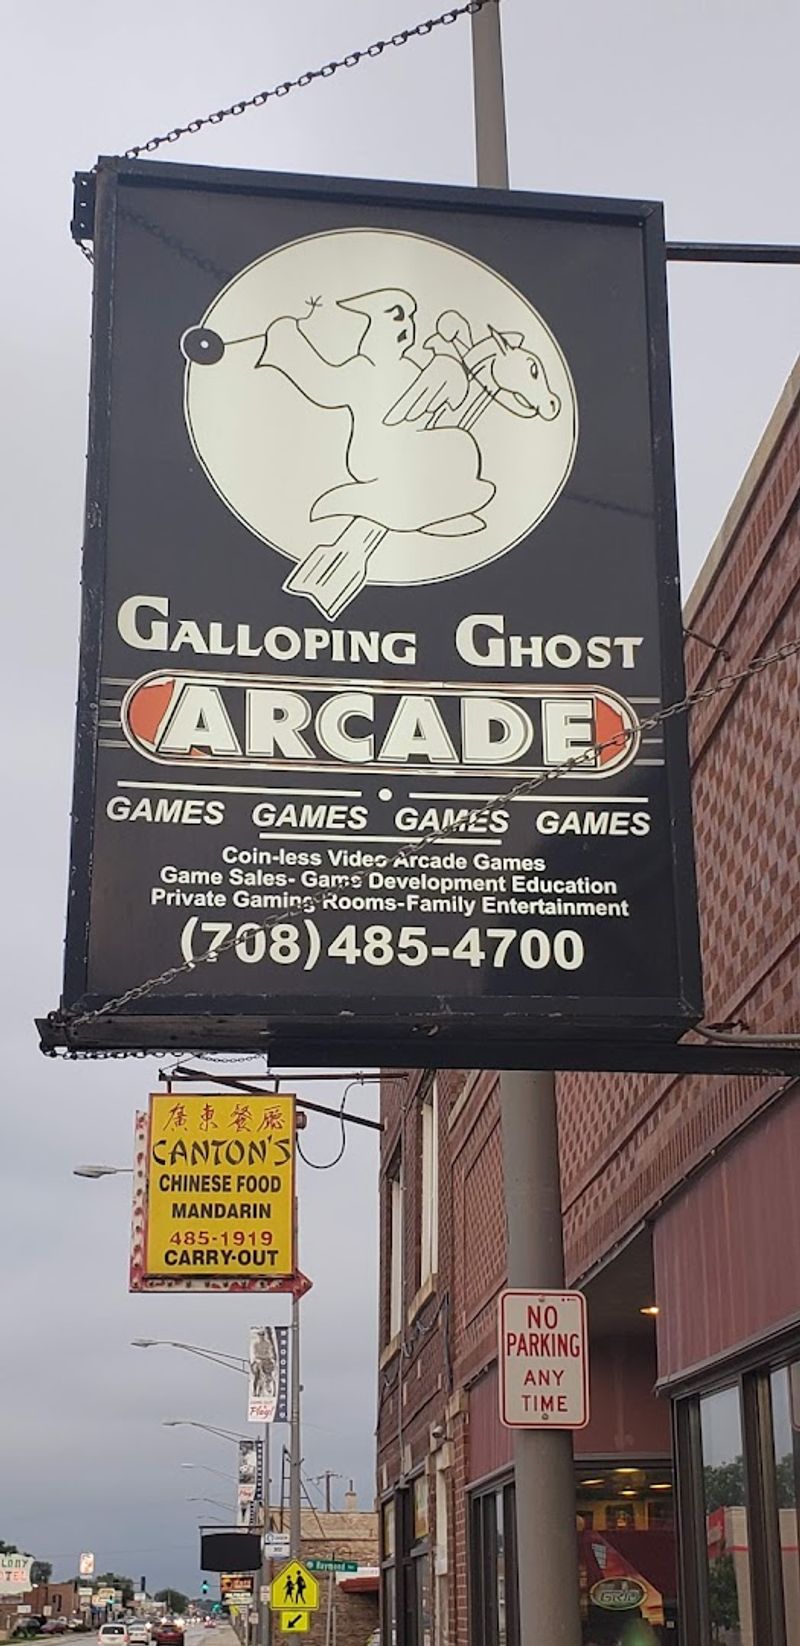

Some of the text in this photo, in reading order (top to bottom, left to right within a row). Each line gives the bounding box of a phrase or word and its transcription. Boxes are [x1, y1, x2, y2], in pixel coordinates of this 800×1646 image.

[117, 595, 644, 669] GALLOPING GHOST
[157, 683, 597, 767] ARCADE
[106, 796, 650, 836] GAMES GAMES GAMES GAMES
[222, 846, 546, 871] Coin-less Video Arcade Games
[160, 866, 223, 885] Game
[229, 868, 295, 886] Sales-
[369, 872, 506, 894] Development
[512, 876, 617, 895] Education
[151, 888, 226, 907] Private
[233, 890, 316, 913] Gaming
[482, 896, 629, 917] Entertainment
[152, 1135, 291, 1166] CANTON'S
[159, 1174, 281, 1193] CHINESE FOOD
[172, 1203, 271, 1219] MANDARIN
[170, 1231, 273, 1246] 485-1919
[164, 1250, 279, 1266] CARRY-OUT
[527, 1305, 558, 1330] NO
[507, 1333, 580, 1358] PARKING
[524, 1369, 564, 1386] ANY
[521, 1395, 568, 1412] TIME
